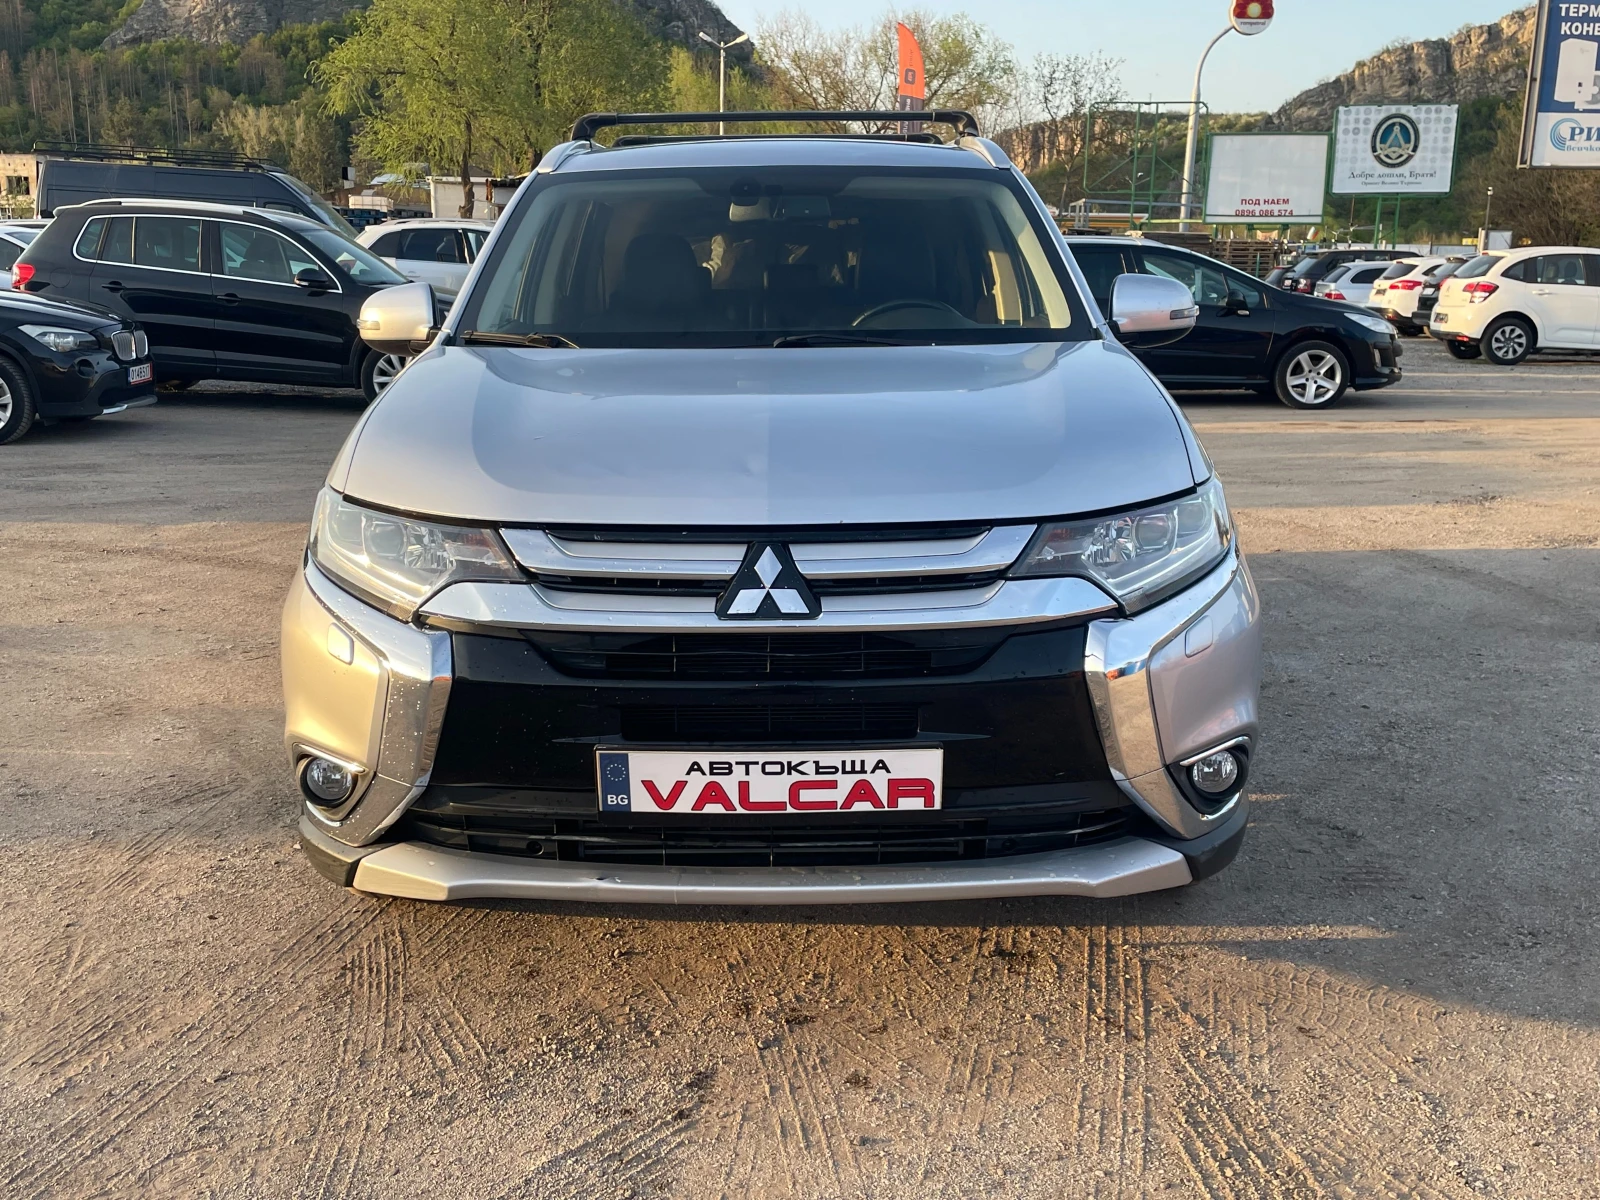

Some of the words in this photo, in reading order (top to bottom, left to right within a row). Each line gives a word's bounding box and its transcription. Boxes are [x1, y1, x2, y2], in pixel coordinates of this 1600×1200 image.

[1559, 3, 1600, 17] ТЕРМ
[1348, 171, 1375, 180] Добре
[1240, 198, 1261, 206] ПОД
[685, 759, 892, 776] АВТОКЪЩА
[607, 794, 628, 805] BG
[641, 778, 936, 812] VALCAR
